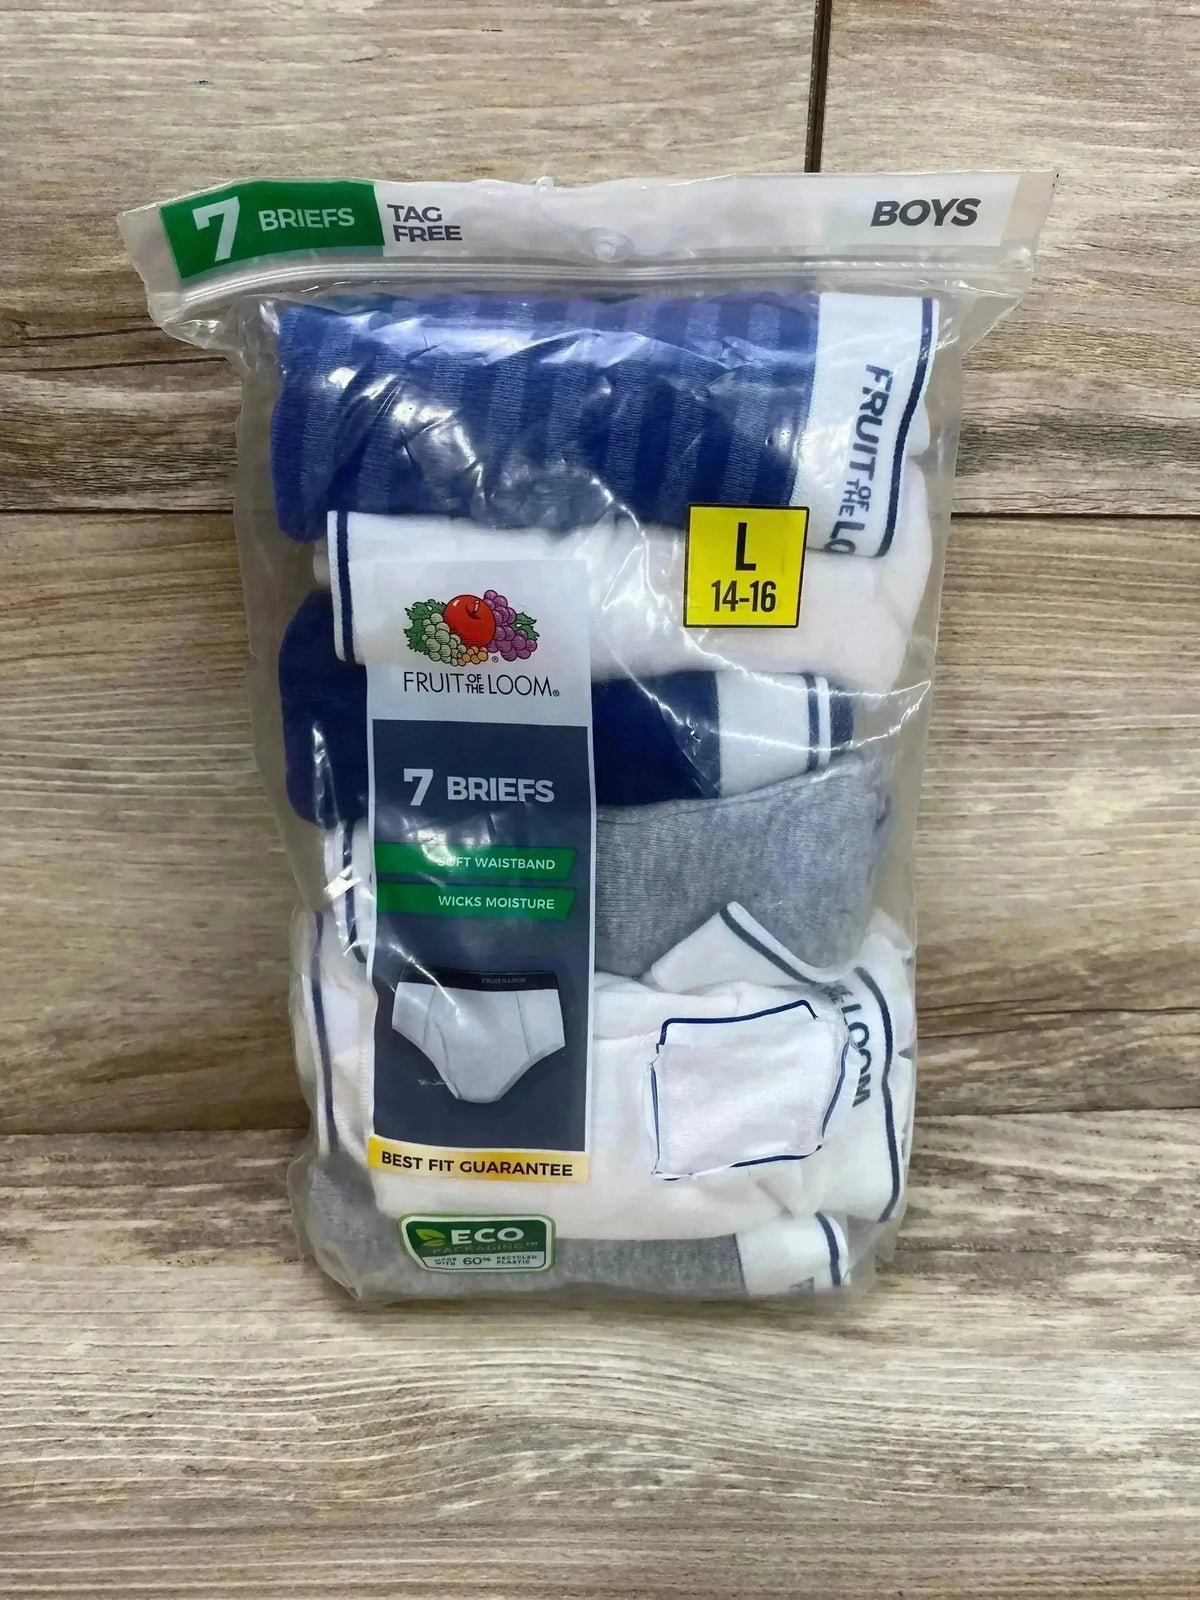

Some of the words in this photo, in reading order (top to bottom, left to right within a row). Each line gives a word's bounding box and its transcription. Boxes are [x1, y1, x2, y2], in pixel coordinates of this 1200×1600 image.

[386, 204, 442, 223] TAG
[870, 198, 982, 227] BOYS
[192, 196, 240, 262] 7
[258, 207, 355, 232] BRIEFS
[393, 224, 463, 242] FREE
[849, 364, 892, 481] FRUIT
[839, 479, 860, 516] THE
[857, 486, 872, 512] OF
[734, 522, 757, 571] L
[711, 580, 777, 612] 14-16
[403, 672, 464, 694] FRUIT
[465, 683, 485, 694] THE
[467, 674, 482, 684] OF
[403, 768, 434, 806] 7
[447, 776, 555, 803] BRIEFS
[475, 857, 556, 870] WAISTBAND
[438, 895, 482, 907] WICKS
[486, 897, 555, 910] MOISTURE
[381, 1151, 423, 1171] BEST
[428, 1159, 455, 1172] FIT
[459, 1160, 573, 1177] GUARANTEE
[451, 1227, 525, 1245] ECO
[462, 1257, 492, 1266] 60%
